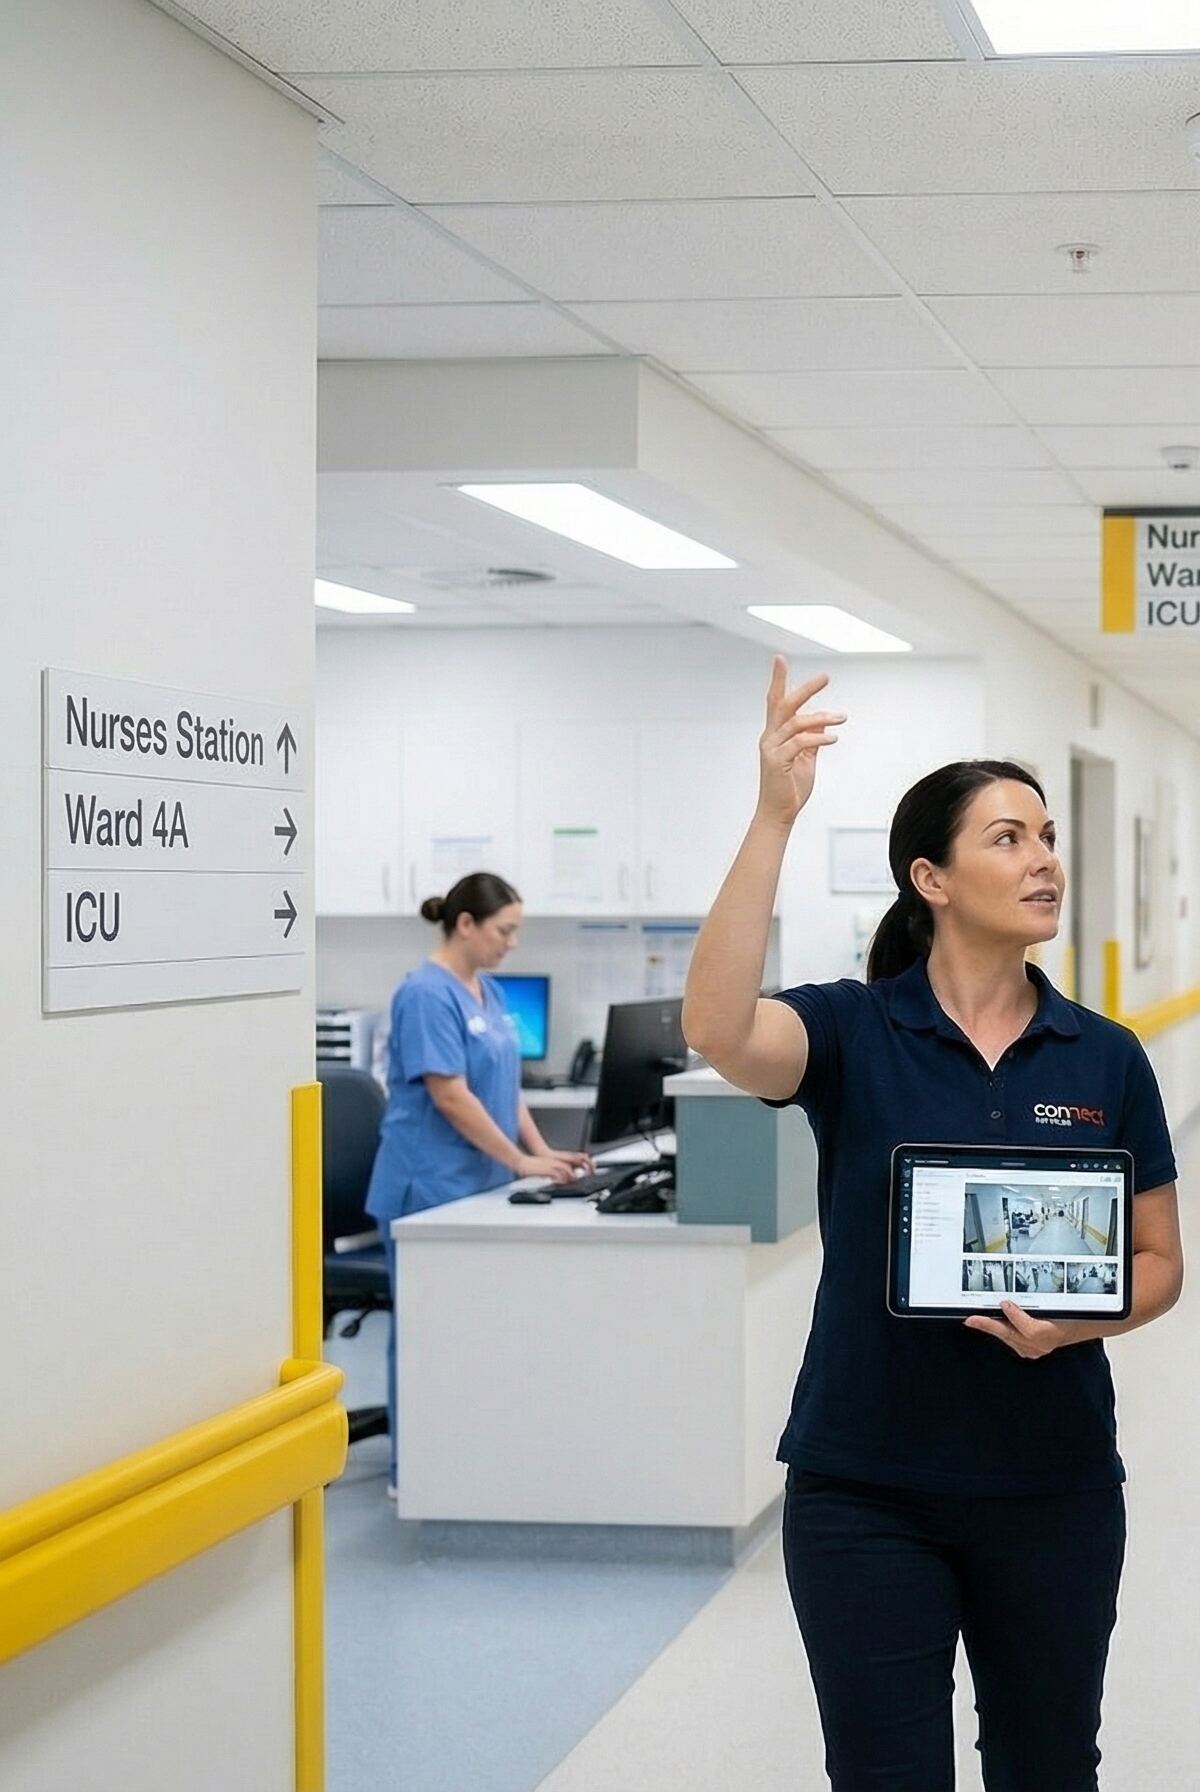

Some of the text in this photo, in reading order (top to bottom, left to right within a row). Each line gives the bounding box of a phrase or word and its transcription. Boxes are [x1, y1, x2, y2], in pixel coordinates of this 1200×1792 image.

[1147, 600, 1200, 626] ICU
[66, 695, 264, 766] Nurses Station
[65, 793, 189, 848] Ward 4A
[66, 891, 120, 944] ICU
